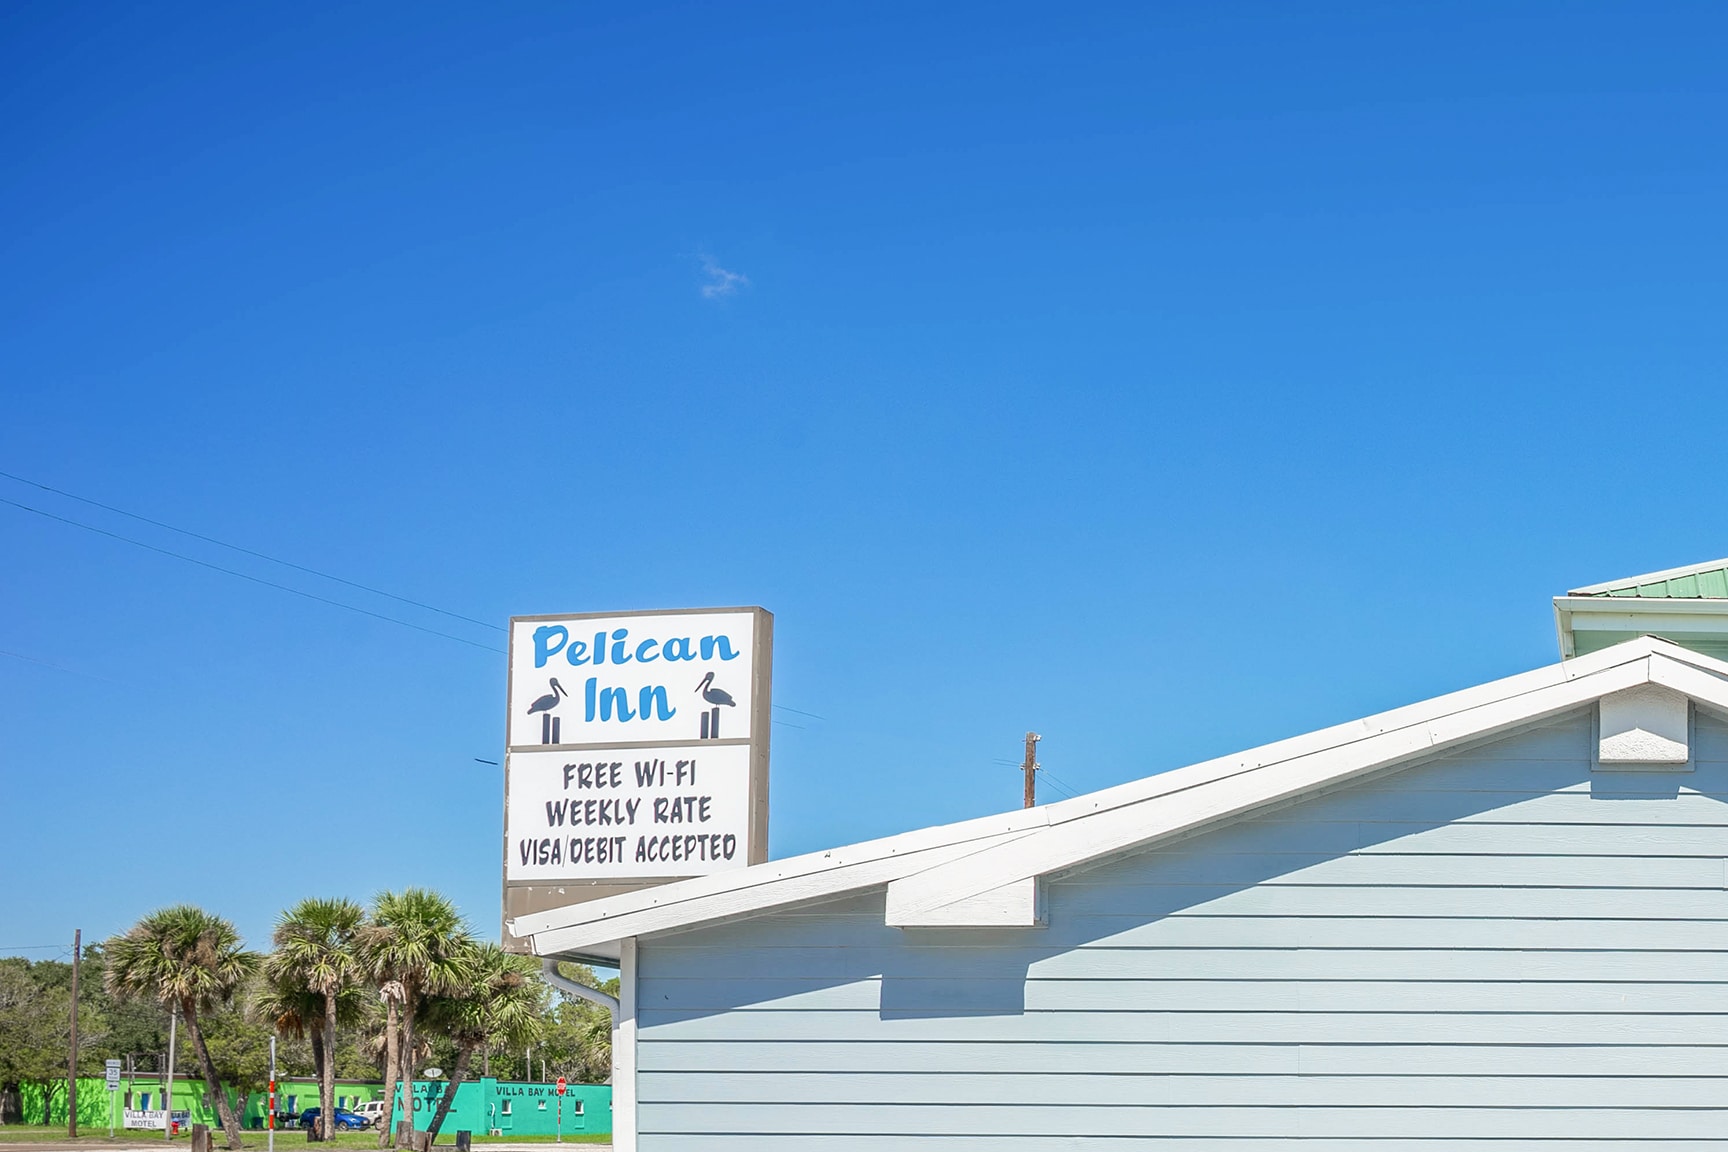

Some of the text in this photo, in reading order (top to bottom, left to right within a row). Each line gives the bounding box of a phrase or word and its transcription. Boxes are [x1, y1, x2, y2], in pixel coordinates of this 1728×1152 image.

[532, 624, 740, 668] Pelican
[584, 677, 677, 723] Inn
[563, 758, 696, 790] FREE WI-FI
[545, 795, 712, 827] WEEKLY RATE
[519, 833, 737, 868] VISA/DEBIT ACCEPTED
[496, 1086, 524, 1097] VILLA
[528, 1087, 545, 1097] BAY
[124, 1111, 147, 1119] VILLA
[149, 1111, 164, 1119] BAY
